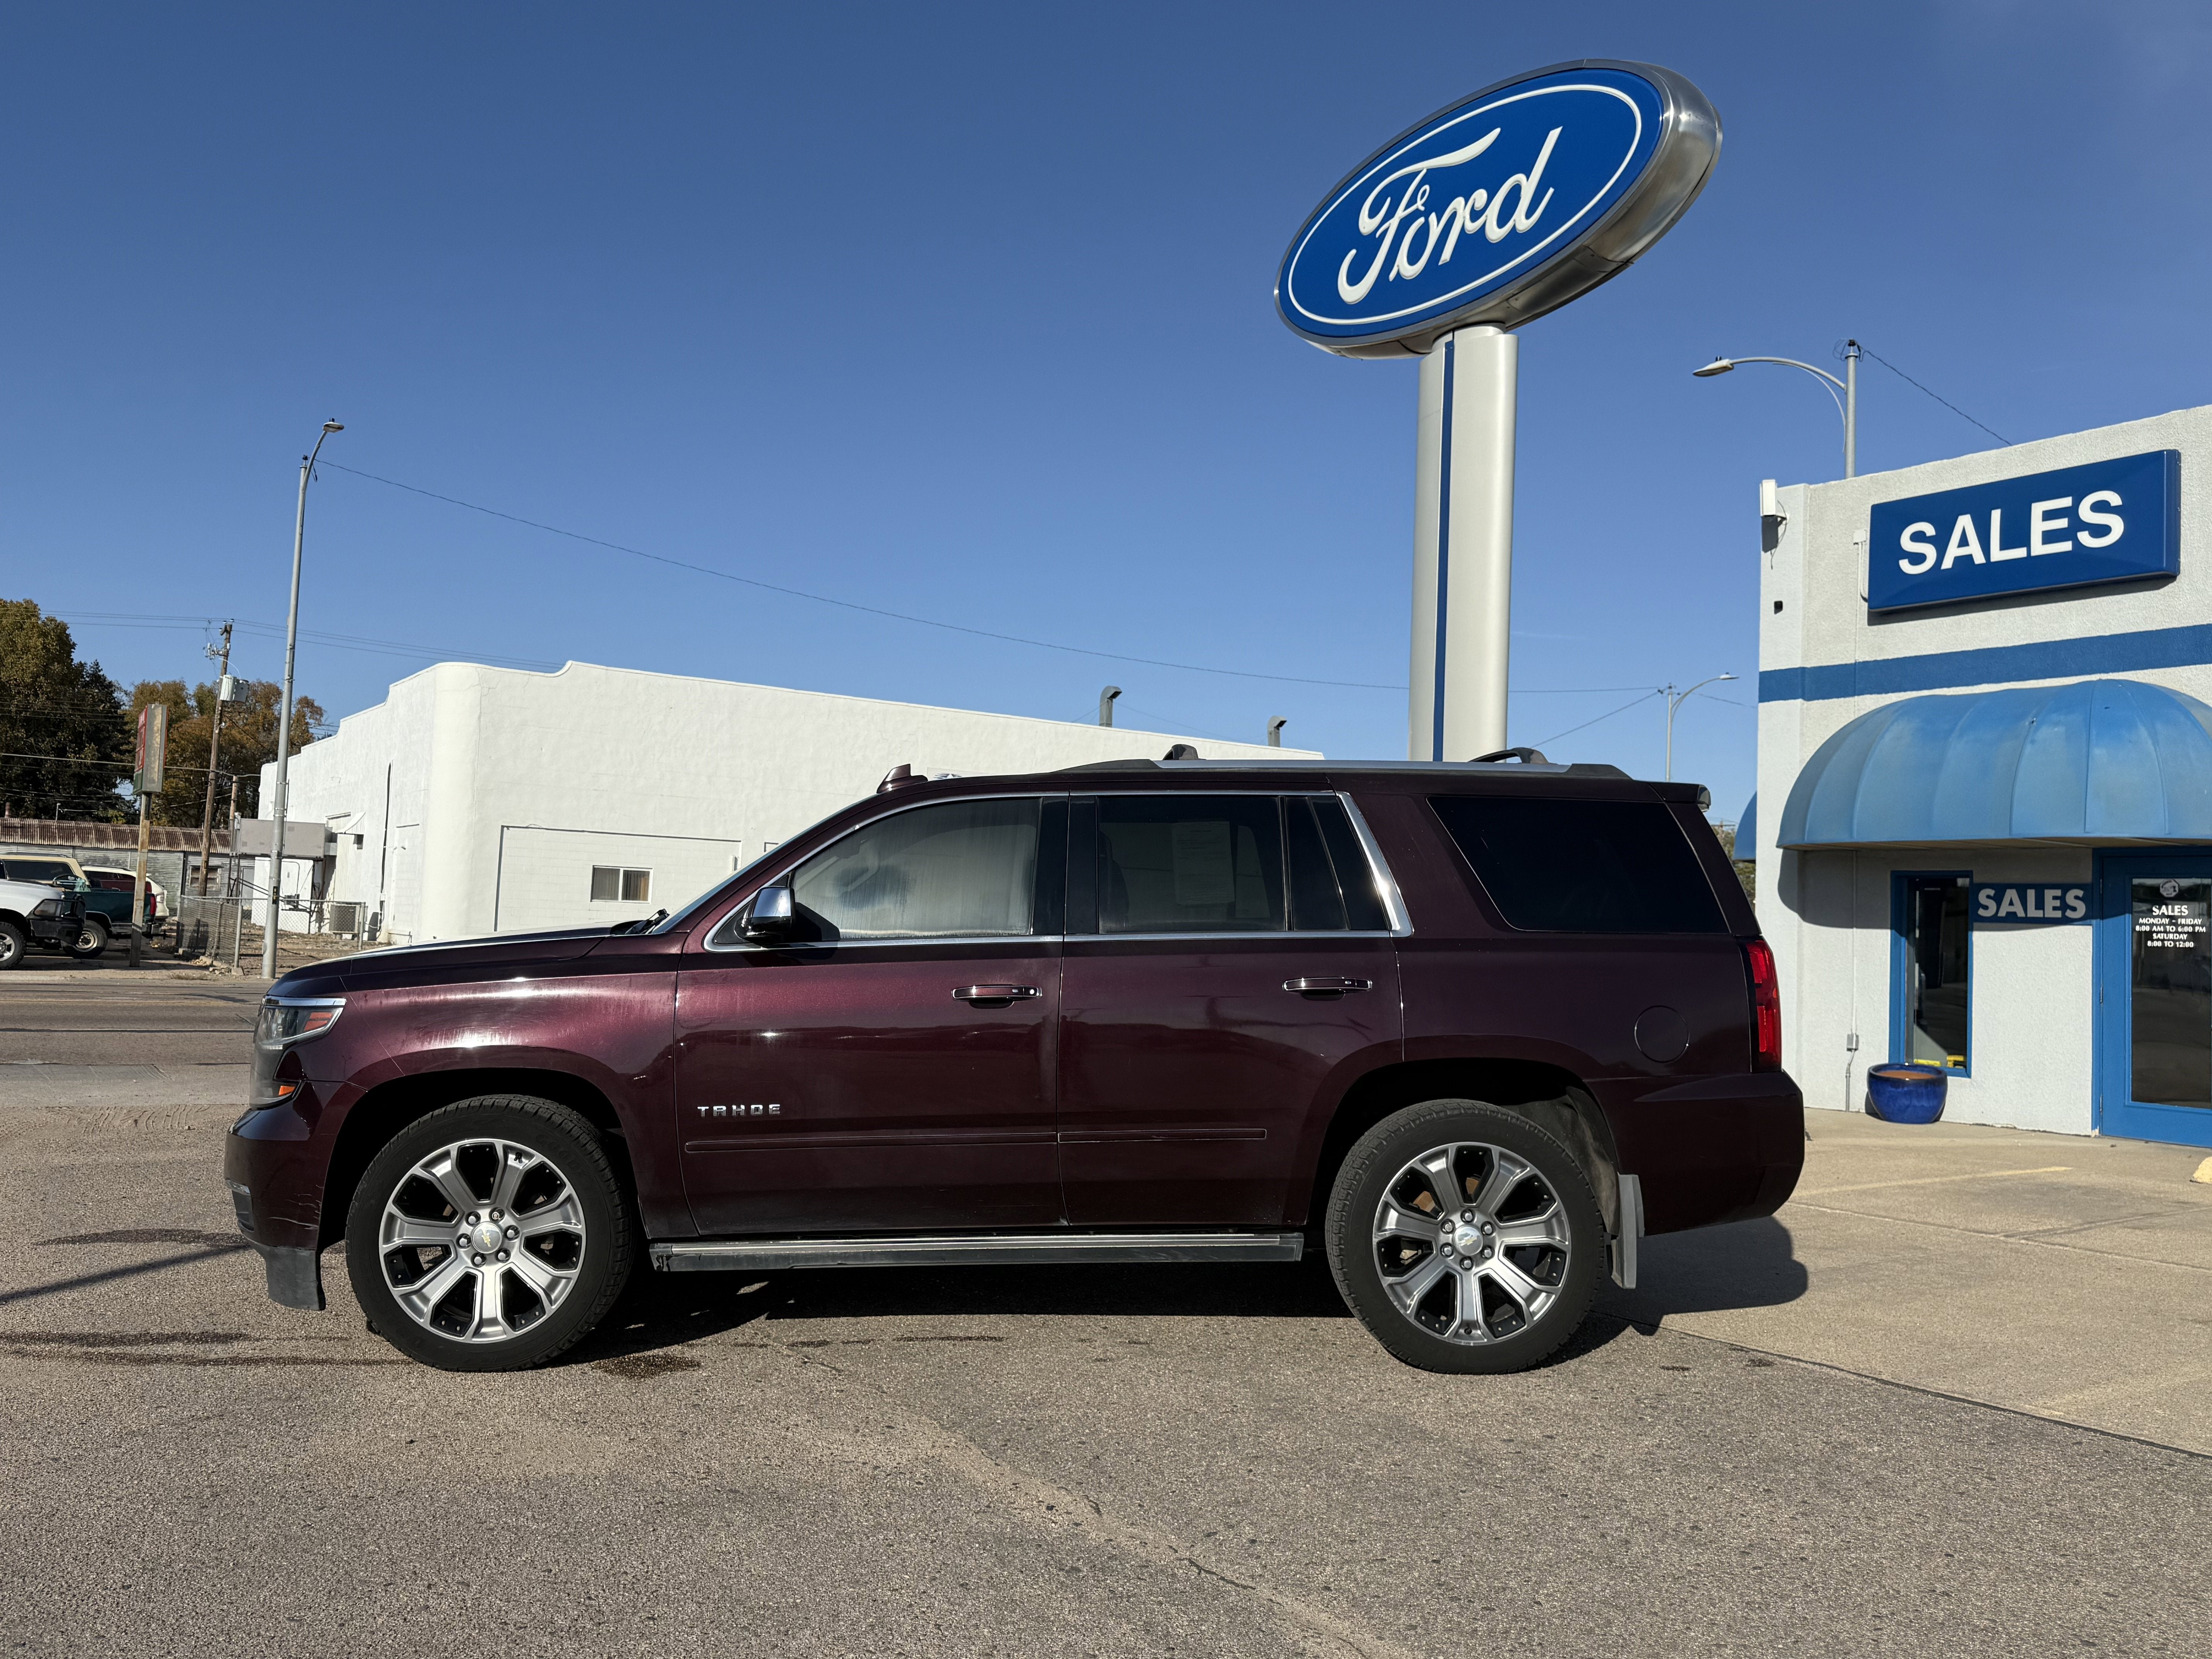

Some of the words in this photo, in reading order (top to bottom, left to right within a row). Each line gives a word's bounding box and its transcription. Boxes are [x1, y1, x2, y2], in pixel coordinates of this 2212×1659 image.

[1338, 126, 1563, 304] Ford
[1899, 490, 2124, 575] SALES
[1978, 888, 2086, 919] SALES
[2152, 905, 2188, 915] SALES
[697, 1104, 780, 1117] TAHOE
